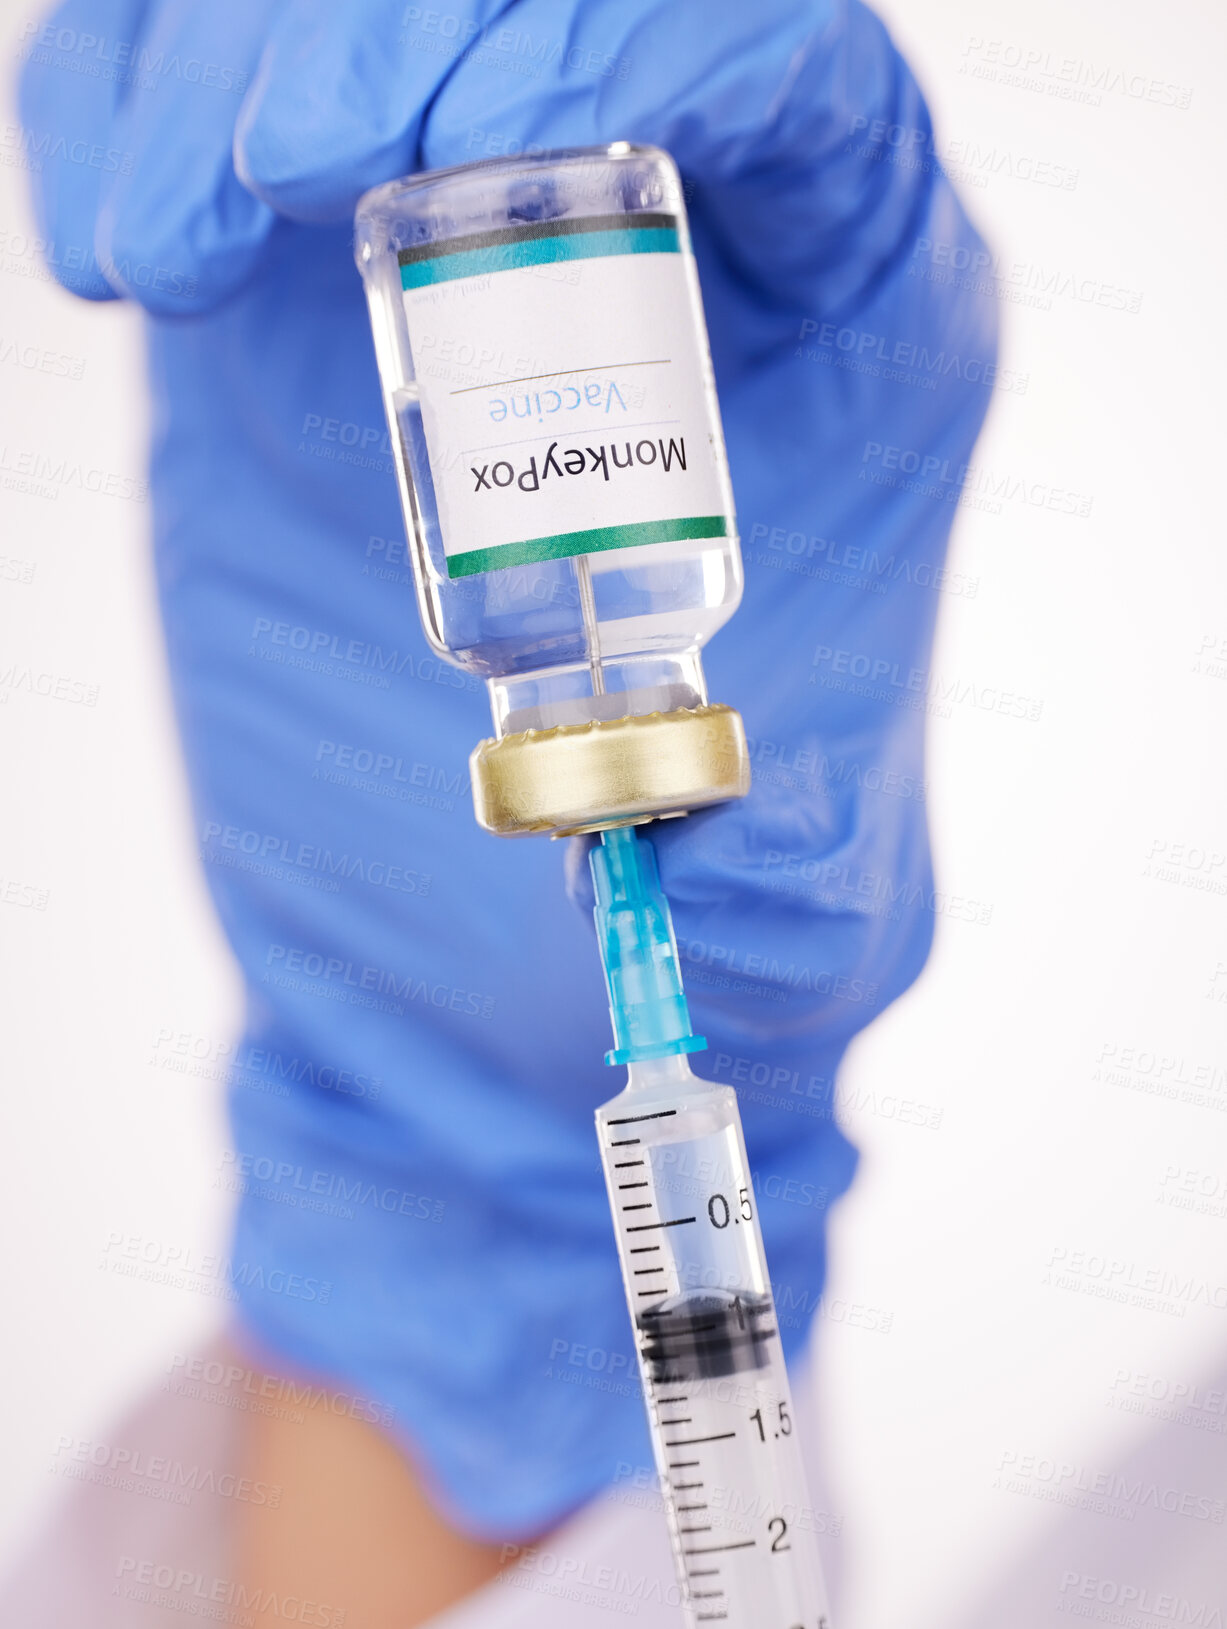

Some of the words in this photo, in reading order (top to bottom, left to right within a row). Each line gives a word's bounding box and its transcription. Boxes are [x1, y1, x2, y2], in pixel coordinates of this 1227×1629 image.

[488, 381, 629, 423] Vaccine
[470, 437, 687, 491] MonkeyPox
[707, 1188, 753, 1229] 0.5
[728, 1296, 745, 1331] 1
[750, 1401, 793, 1443] 1.5
[767, 1517, 791, 1554] 2
